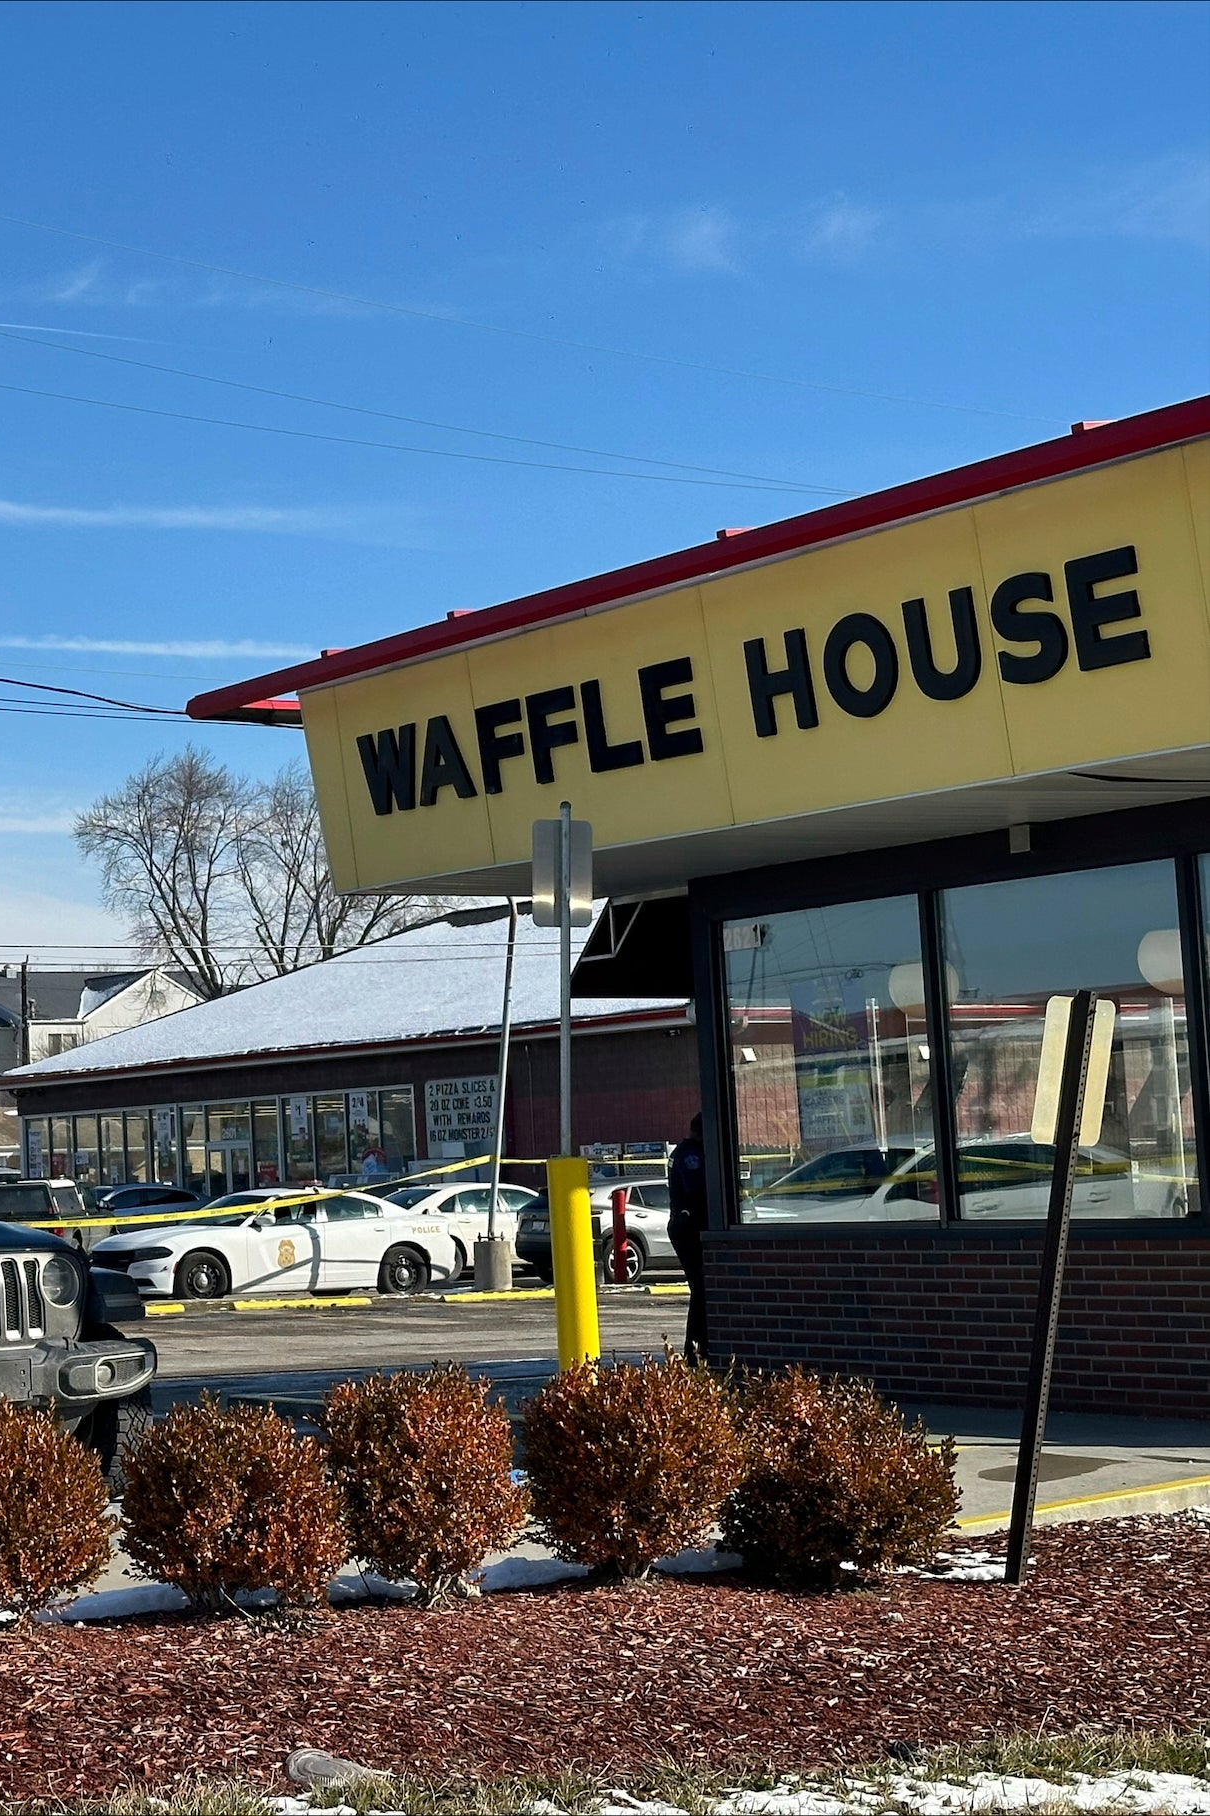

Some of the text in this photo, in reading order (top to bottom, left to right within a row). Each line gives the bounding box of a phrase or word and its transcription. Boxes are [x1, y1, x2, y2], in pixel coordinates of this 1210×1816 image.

[355, 544, 1151, 818] WAFFLE HOUSE
[803, 1026, 857, 1049] HIRING
[429, 1080, 496, 1096] 2 PIZZA SLICES &
[430, 1099, 439, 1111] 20
[441, 1099, 450, 1111] OZ
[452, 1097, 470, 1110] COKE
[433, 1112, 491, 1126] WITH REWARDS
[430, 1130, 437, 1142] 16
[438, 1129, 447, 1141] OZ
[448, 1127, 481, 1141] MONSTER
[411, 1225, 441, 1235] POLICE
